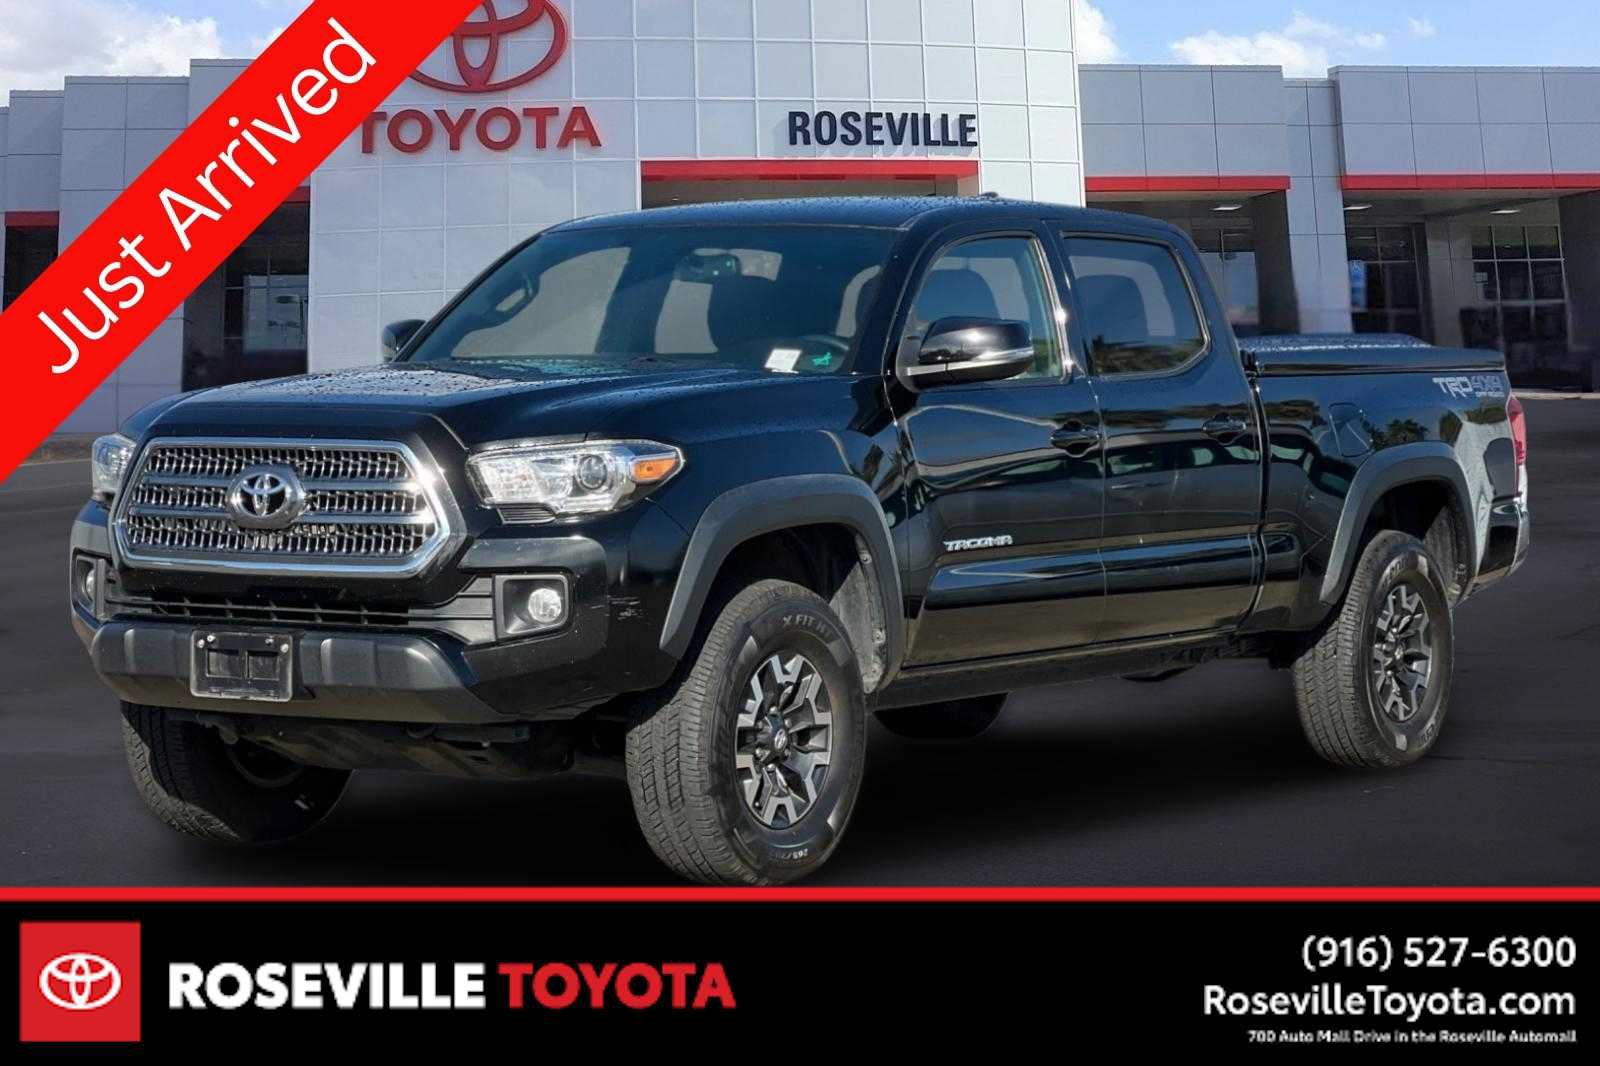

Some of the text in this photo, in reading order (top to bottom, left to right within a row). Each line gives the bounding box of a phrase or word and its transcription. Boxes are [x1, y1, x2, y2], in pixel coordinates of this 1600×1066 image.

[361, 106, 602, 153] TOYOTA
[788, 110, 978, 147] ROSEVILLE
[1432, 376, 1473, 398] TRD
[942, 534, 1013, 552] TACOMA
